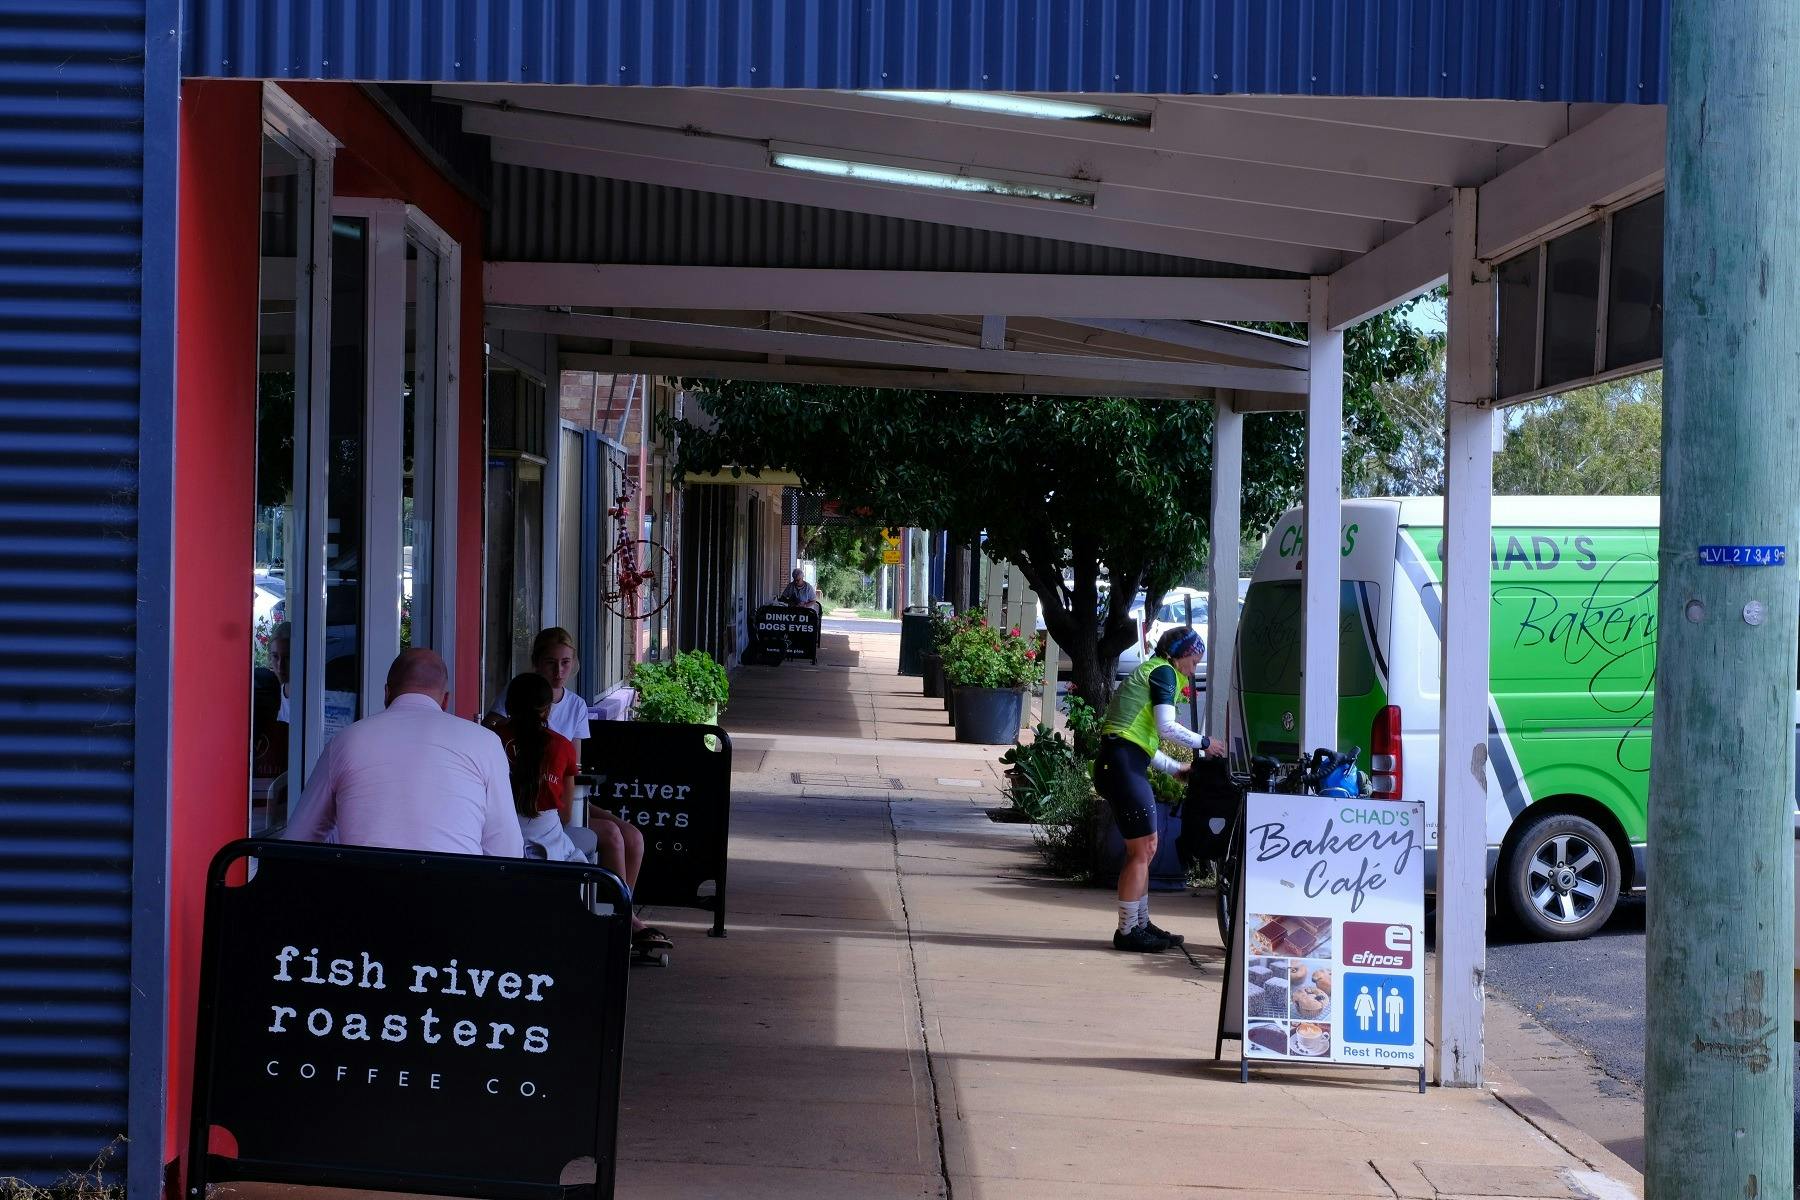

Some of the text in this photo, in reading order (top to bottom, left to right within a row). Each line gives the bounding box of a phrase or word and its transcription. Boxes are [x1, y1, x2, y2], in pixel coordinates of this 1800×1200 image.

[760, 623, 814, 632] DOGS EYES
[766, 613, 809, 623] DINKY DI
[612, 778, 691, 800] river
[1340, 808, 1410, 827] CHAD'S
[1250, 819, 1422, 875] Bakery
[1303, 857, 1387, 913] Café
[1352, 951, 1404, 967] eftpos
[273, 945, 554, 1002] fish river
[268, 1005, 549, 1053] roasters
[1343, 1046, 1415, 1060] Rest Rooms
[267, 1060, 547, 1099] COFFEE CO.
